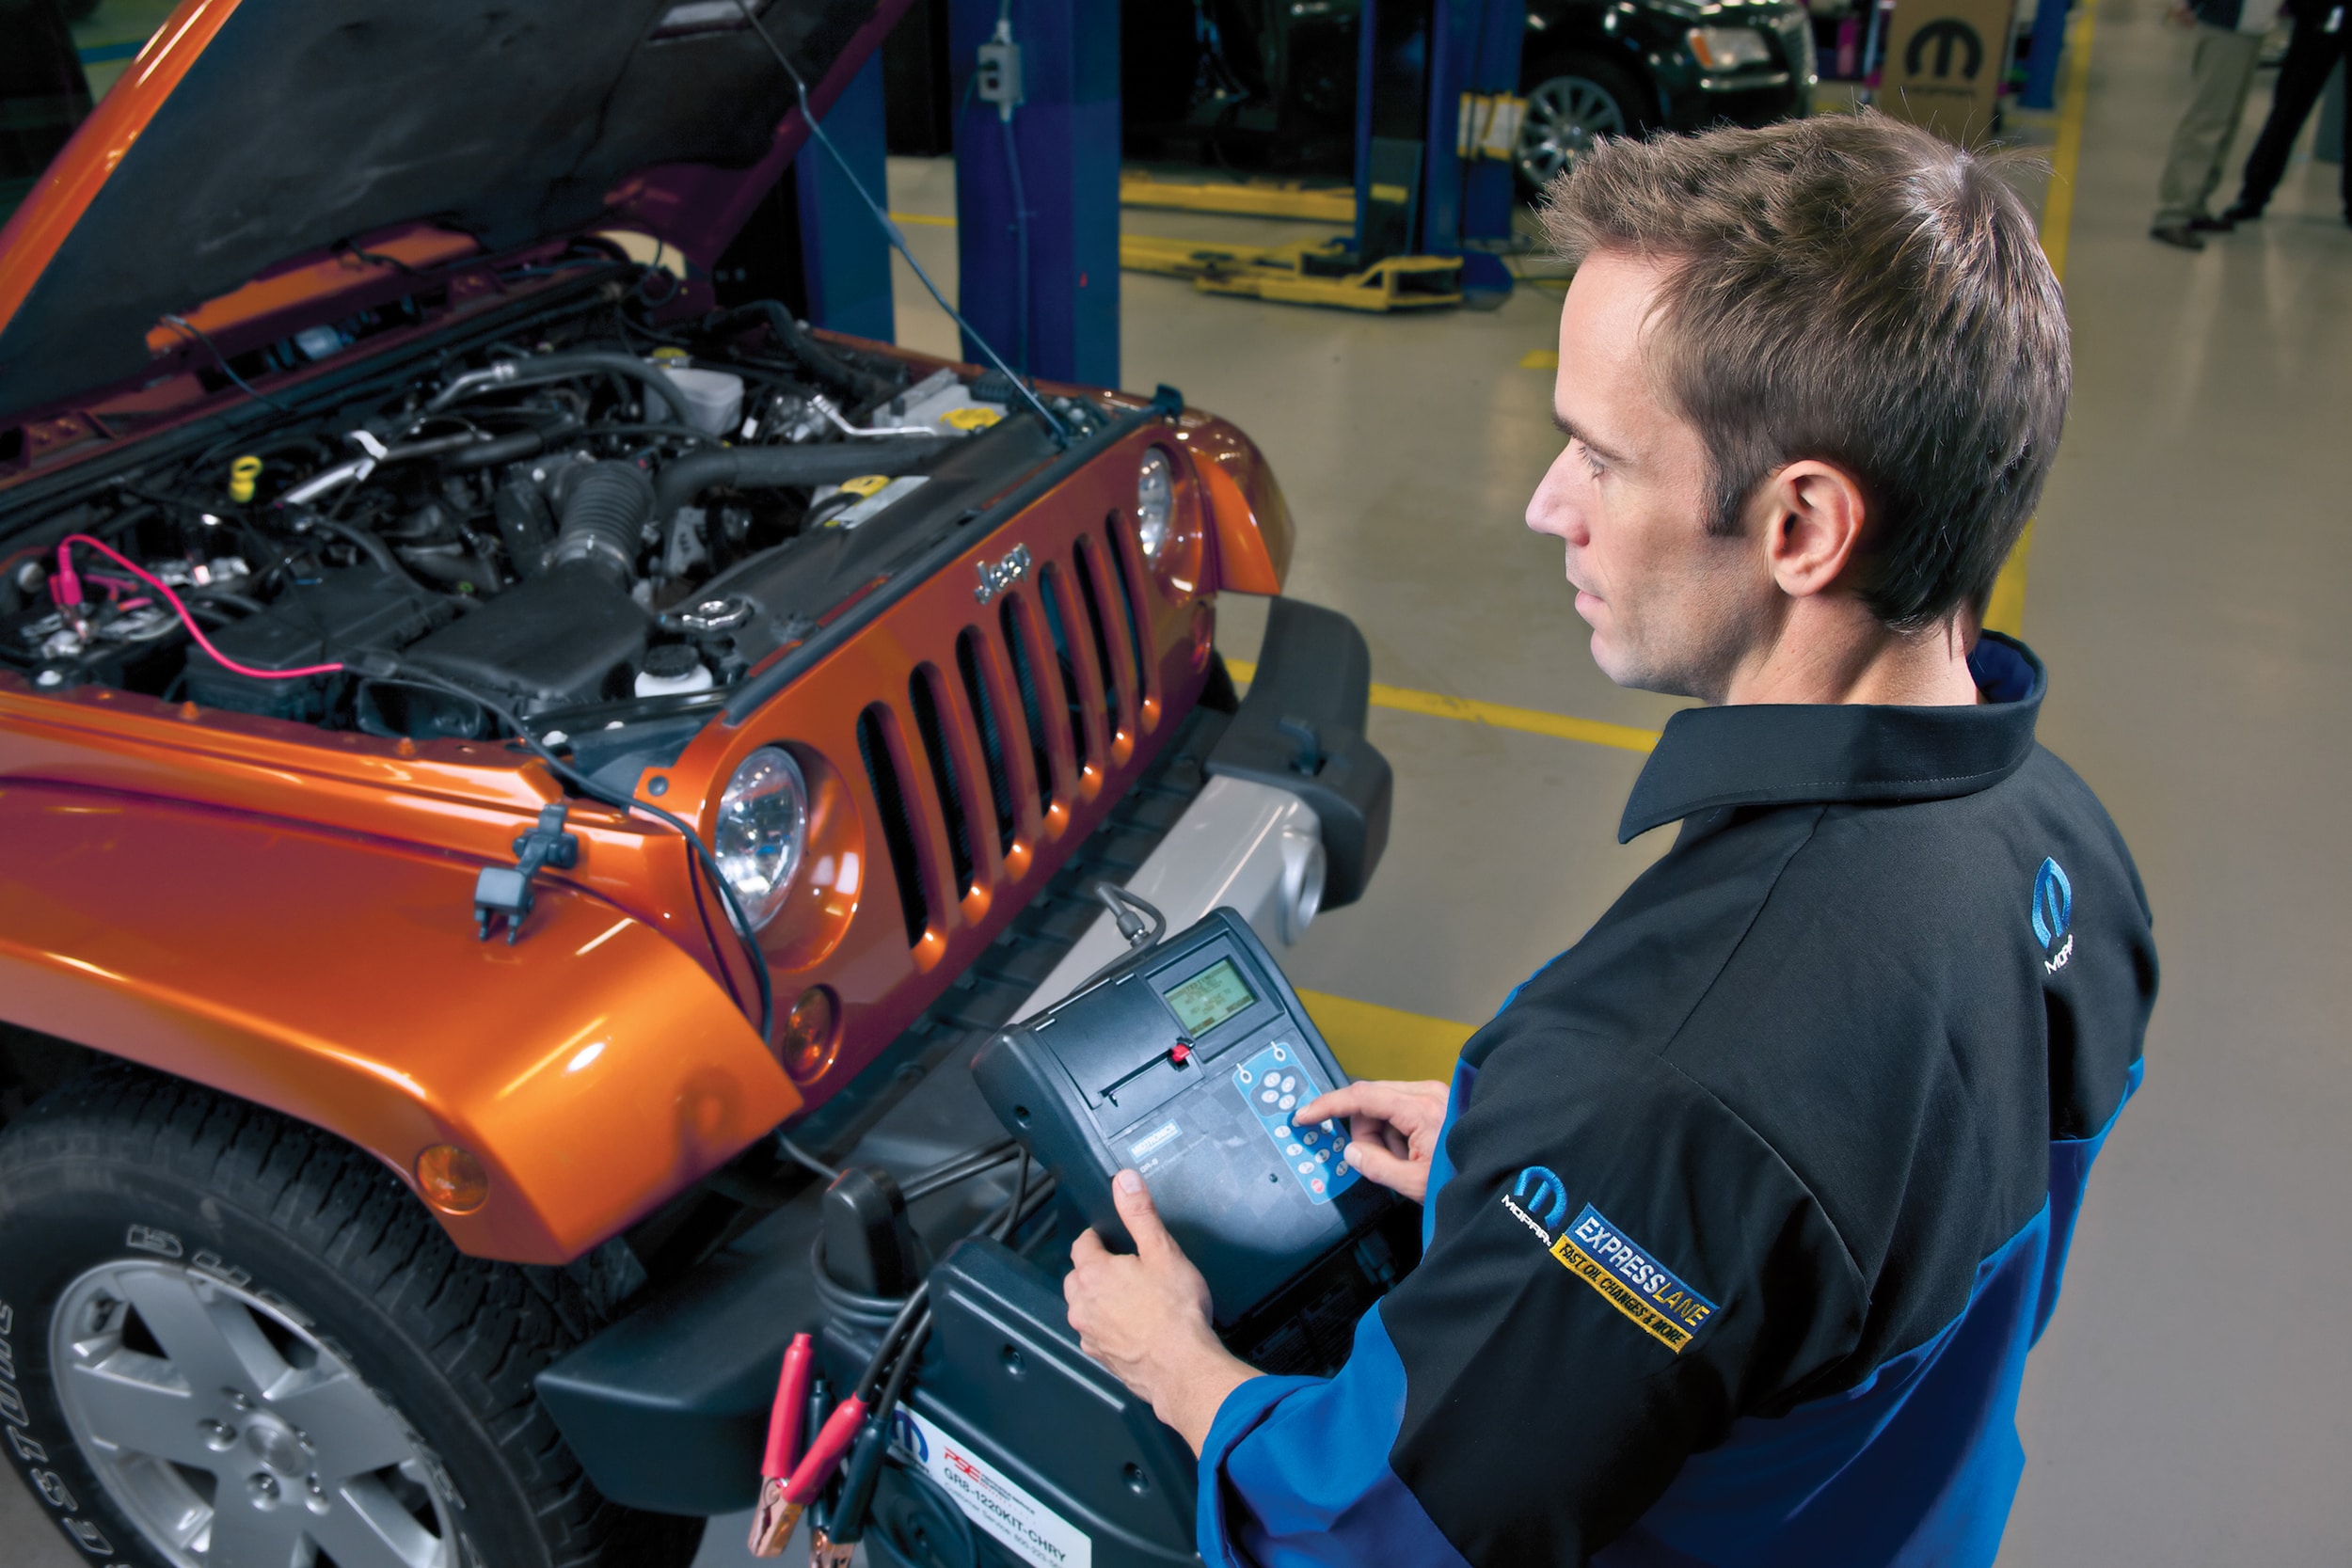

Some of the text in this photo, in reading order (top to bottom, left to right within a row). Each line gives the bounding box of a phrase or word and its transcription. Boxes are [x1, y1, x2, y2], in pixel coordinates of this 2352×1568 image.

[973, 543, 1031, 605] Jeep
[1502, 1194, 1550, 1246] MOPAR
[1559, 1243, 1585, 1269] FAST
[1584, 1265, 1600, 1283] OIL
[1599, 1278, 1649, 1317] CHANGES
[1654, 1319, 1687, 1346] MORE
[945, 1446, 981, 1482] PSE
